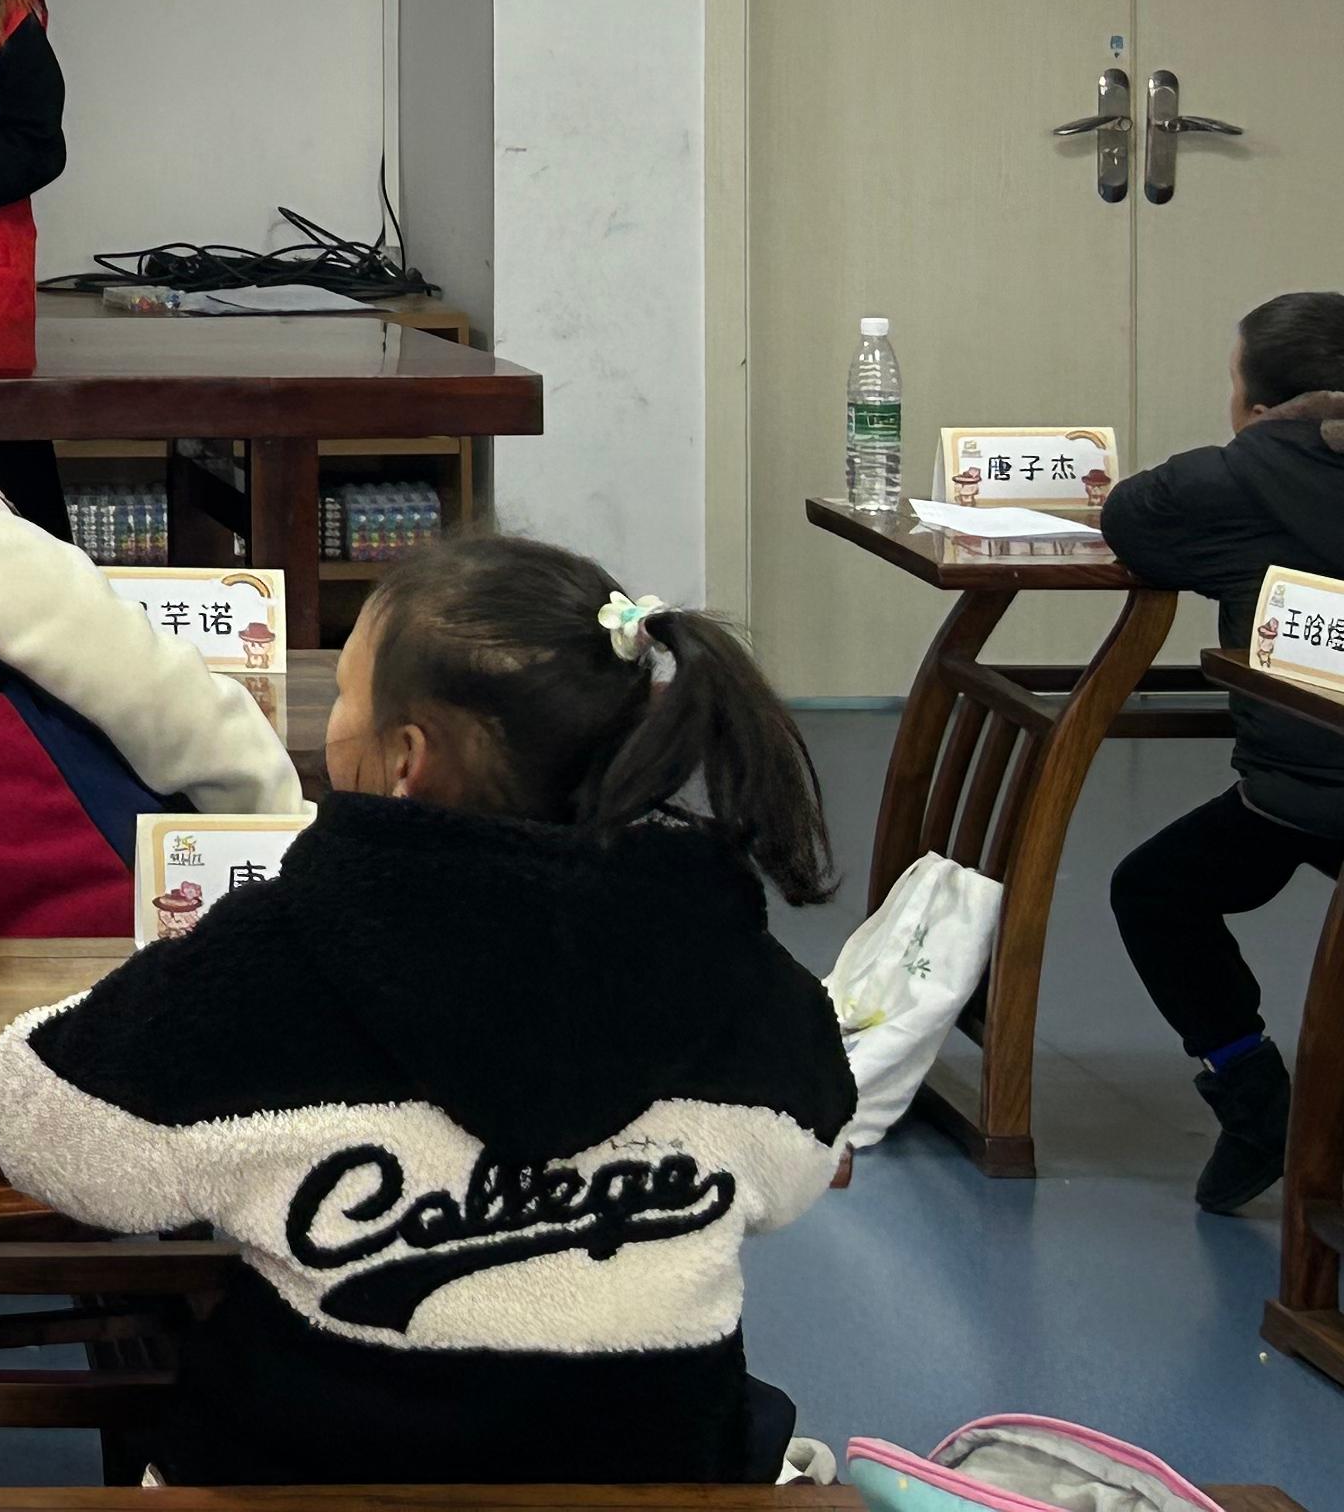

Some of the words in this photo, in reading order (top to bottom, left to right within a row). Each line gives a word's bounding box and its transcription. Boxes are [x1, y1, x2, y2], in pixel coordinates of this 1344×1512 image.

[987, 454, 1077, 481] 唐子杰
[139, 601, 233, 636] 芊诺
[285, 1141, 737, 1273] College
